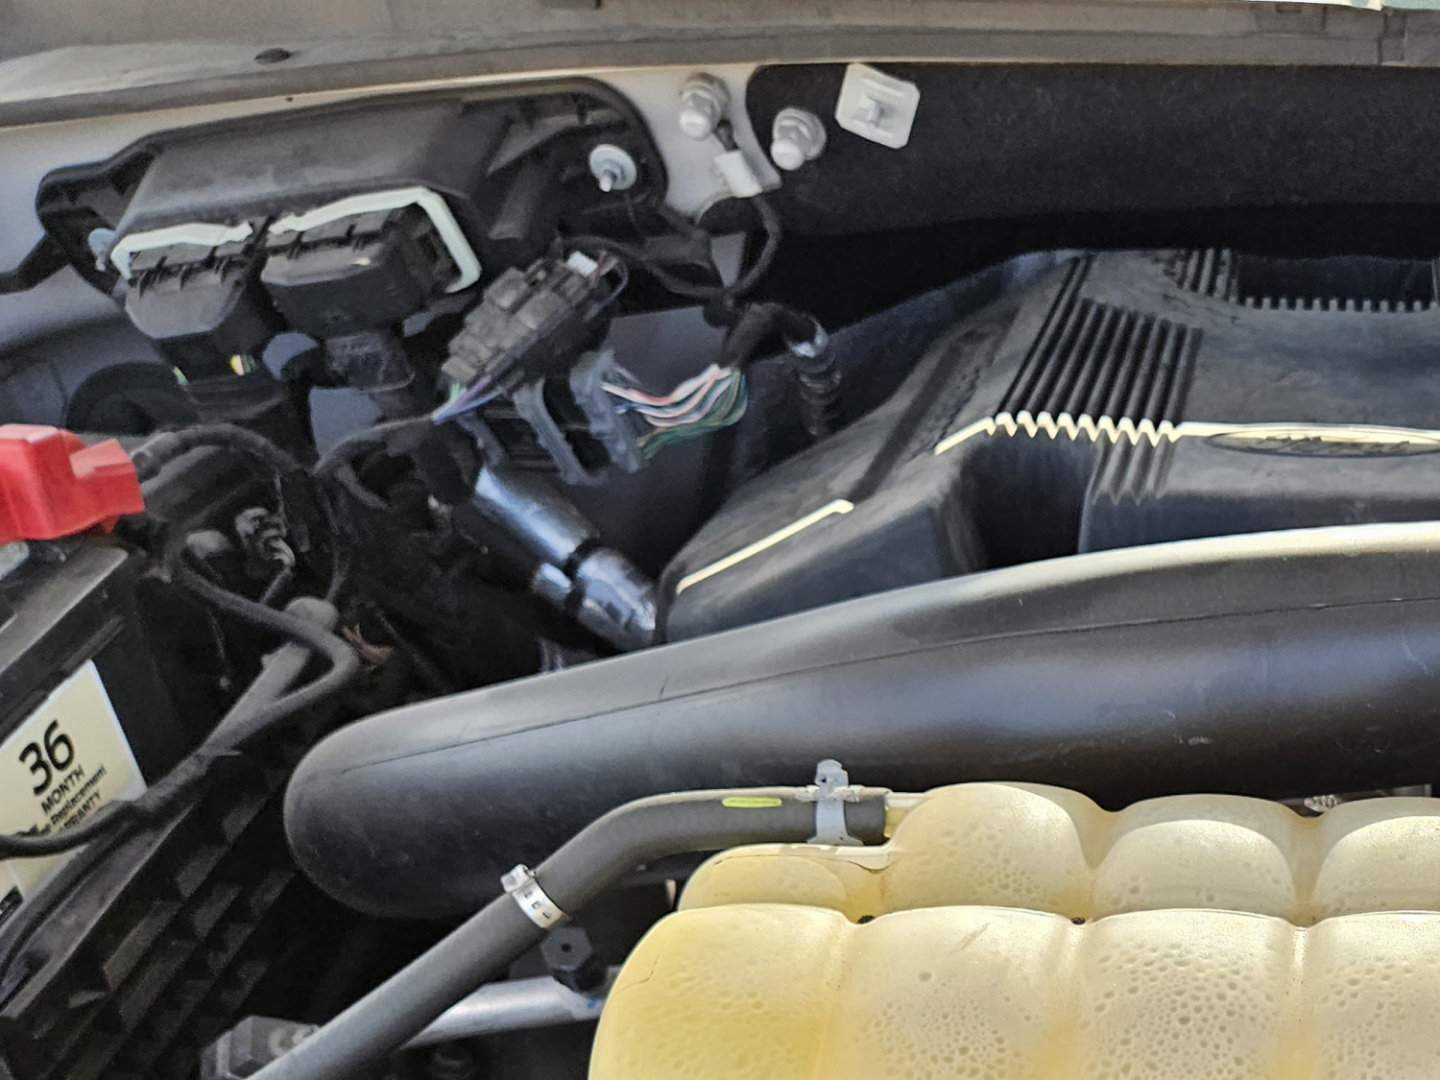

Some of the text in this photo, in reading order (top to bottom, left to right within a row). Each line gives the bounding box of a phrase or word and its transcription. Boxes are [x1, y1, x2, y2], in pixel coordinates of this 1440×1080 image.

[18, 719, 75, 797] 36
[41, 764, 85, 816] MONTH
[50, 764, 107, 825] Replacement
